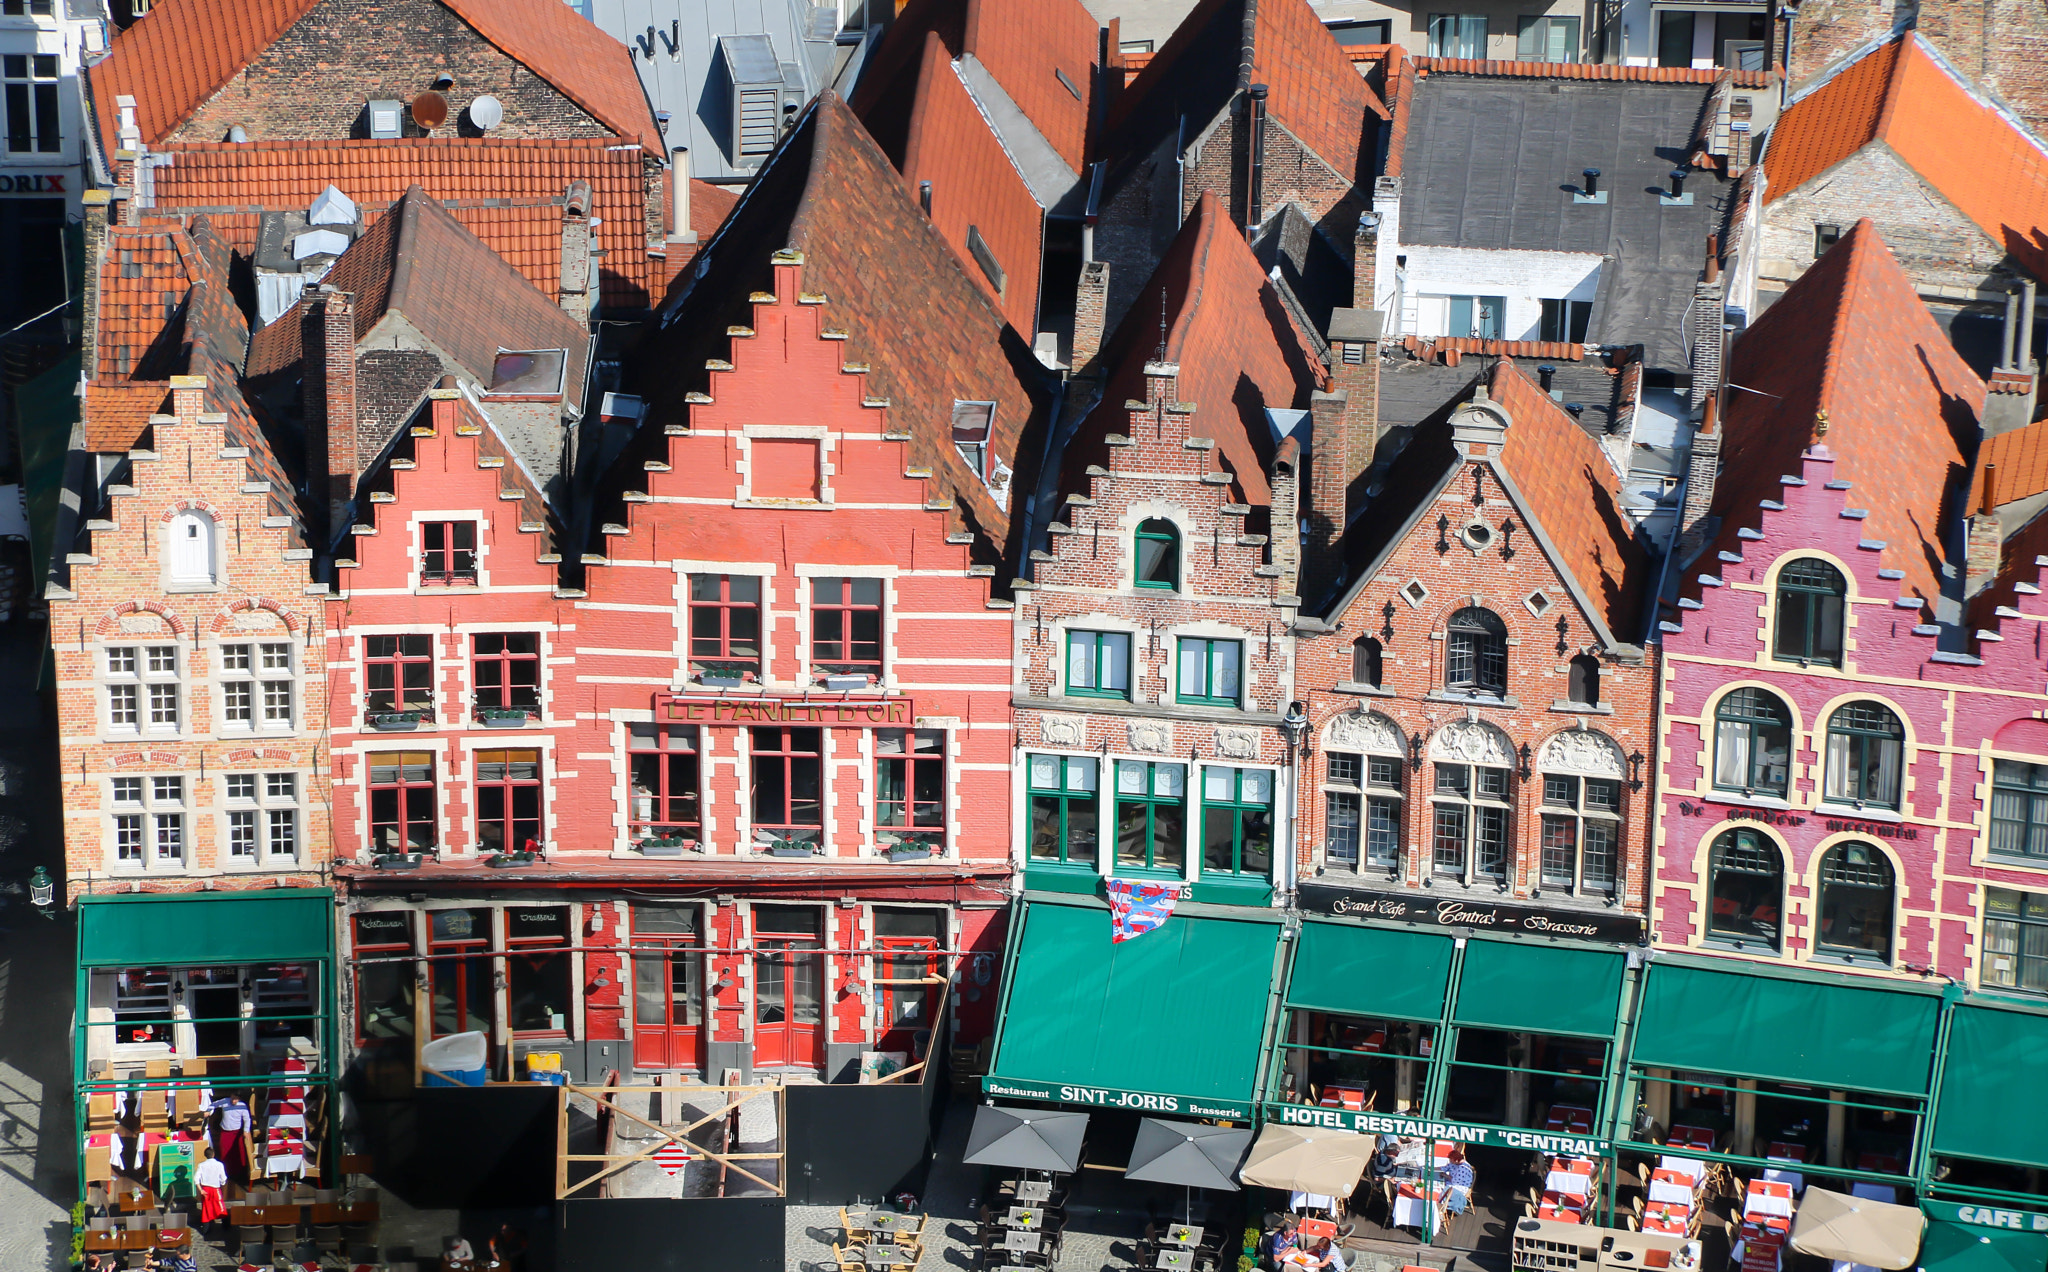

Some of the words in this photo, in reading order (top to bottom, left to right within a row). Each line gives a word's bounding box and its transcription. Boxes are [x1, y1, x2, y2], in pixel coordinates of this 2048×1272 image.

[989, 1083, 1050, 1098] Restaurant
[1060, 1085, 1179, 1112] SINT-JORIS
[1189, 1104, 1242, 1118] Brasserie
[1283, 1106, 1346, 1128] HOTEL
[1355, 1115, 1488, 1144] RESTAURANT
[1498, 1130, 1609, 1157] "CENTRAL"
[1958, 1206, 2023, 1229] CAFE
